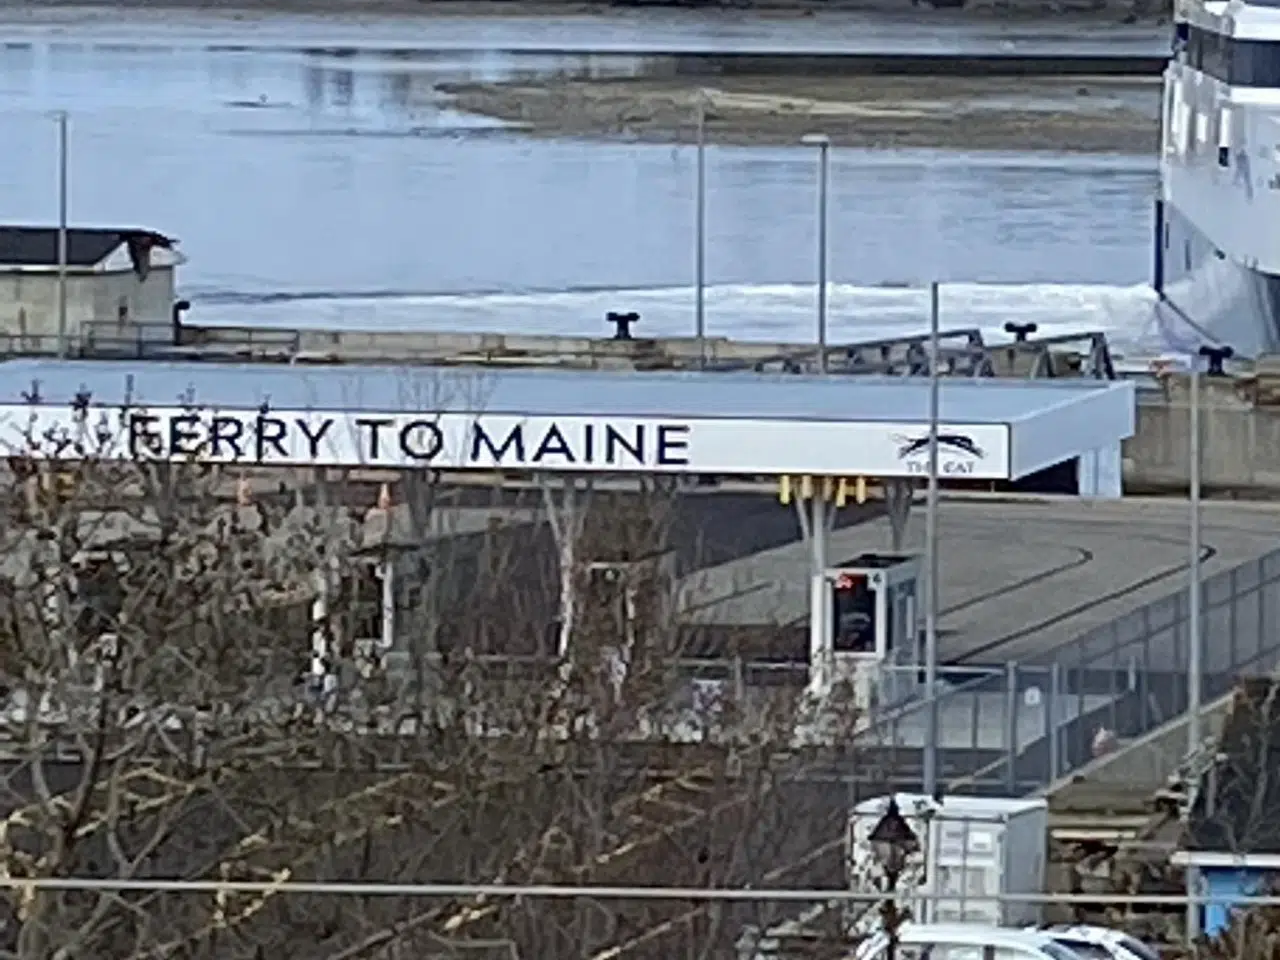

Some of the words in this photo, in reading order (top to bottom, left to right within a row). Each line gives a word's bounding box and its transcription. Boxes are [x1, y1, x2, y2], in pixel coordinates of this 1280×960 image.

[129, 415, 334, 458] FERRY
[355, 419, 443, 460] TO
[470, 421, 690, 465] MAINE
[943, 461, 975, 473] CAT
